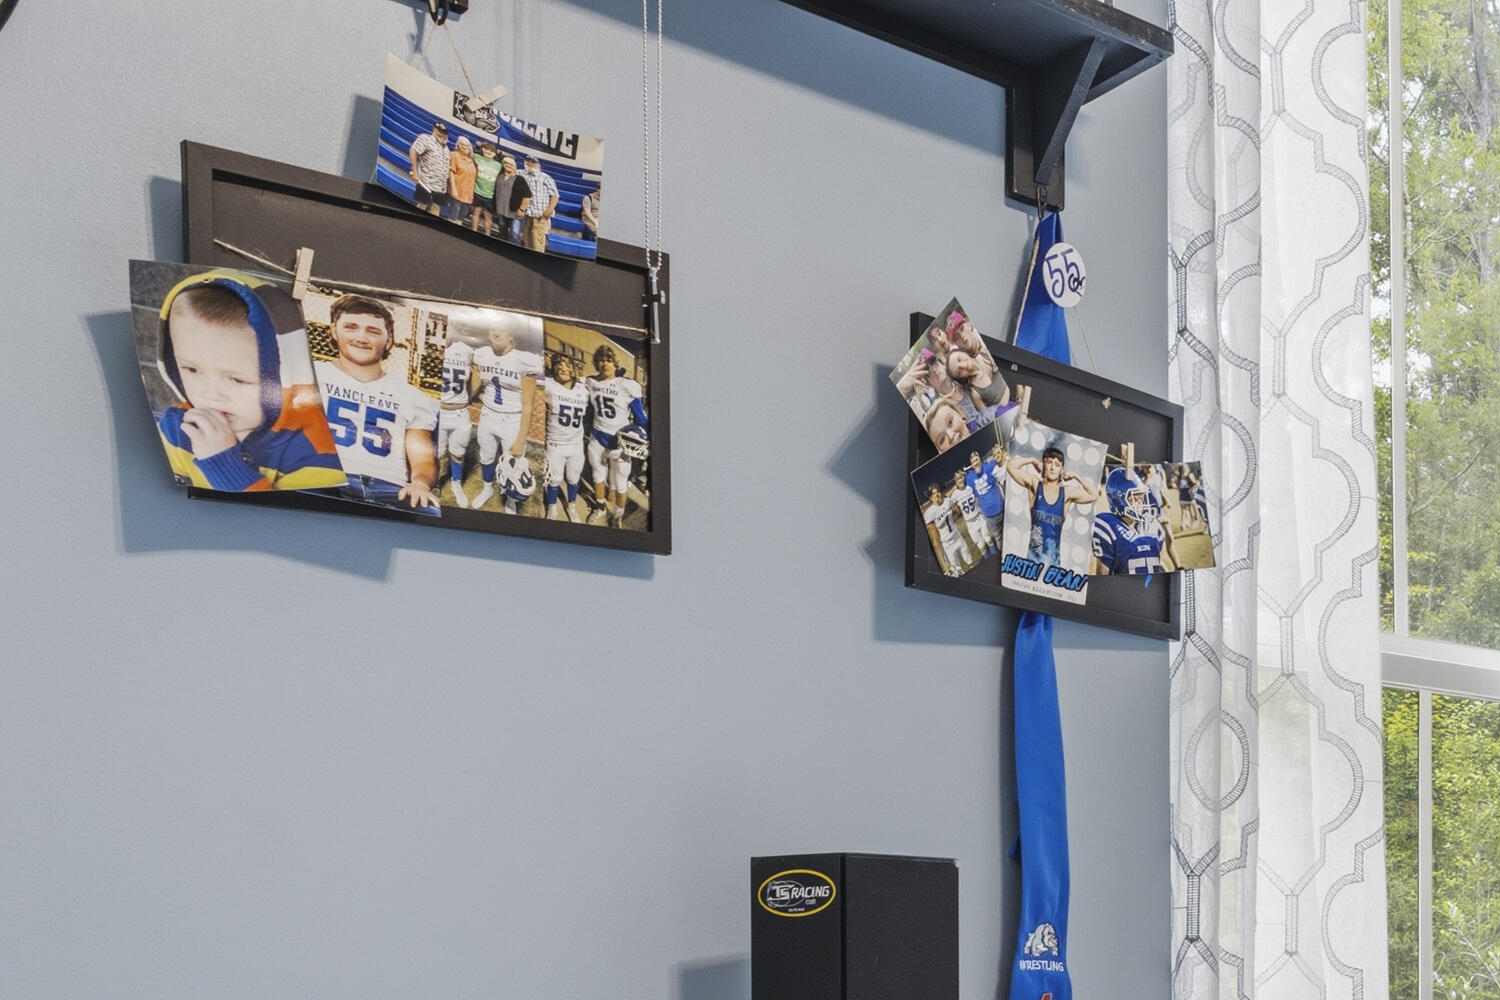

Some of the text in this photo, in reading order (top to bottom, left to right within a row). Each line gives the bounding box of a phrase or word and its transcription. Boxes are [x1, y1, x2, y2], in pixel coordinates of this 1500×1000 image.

[326, 383, 400, 411] VANCLEAVE
[594, 394, 617, 419] 15
[326, 396, 396, 457] 55
[558, 404, 584, 428] 55
[1043, 564, 1089, 592] BEAN
[791, 885, 830, 899] RACING
[1019, 960, 1064, 971] WRESTLING
